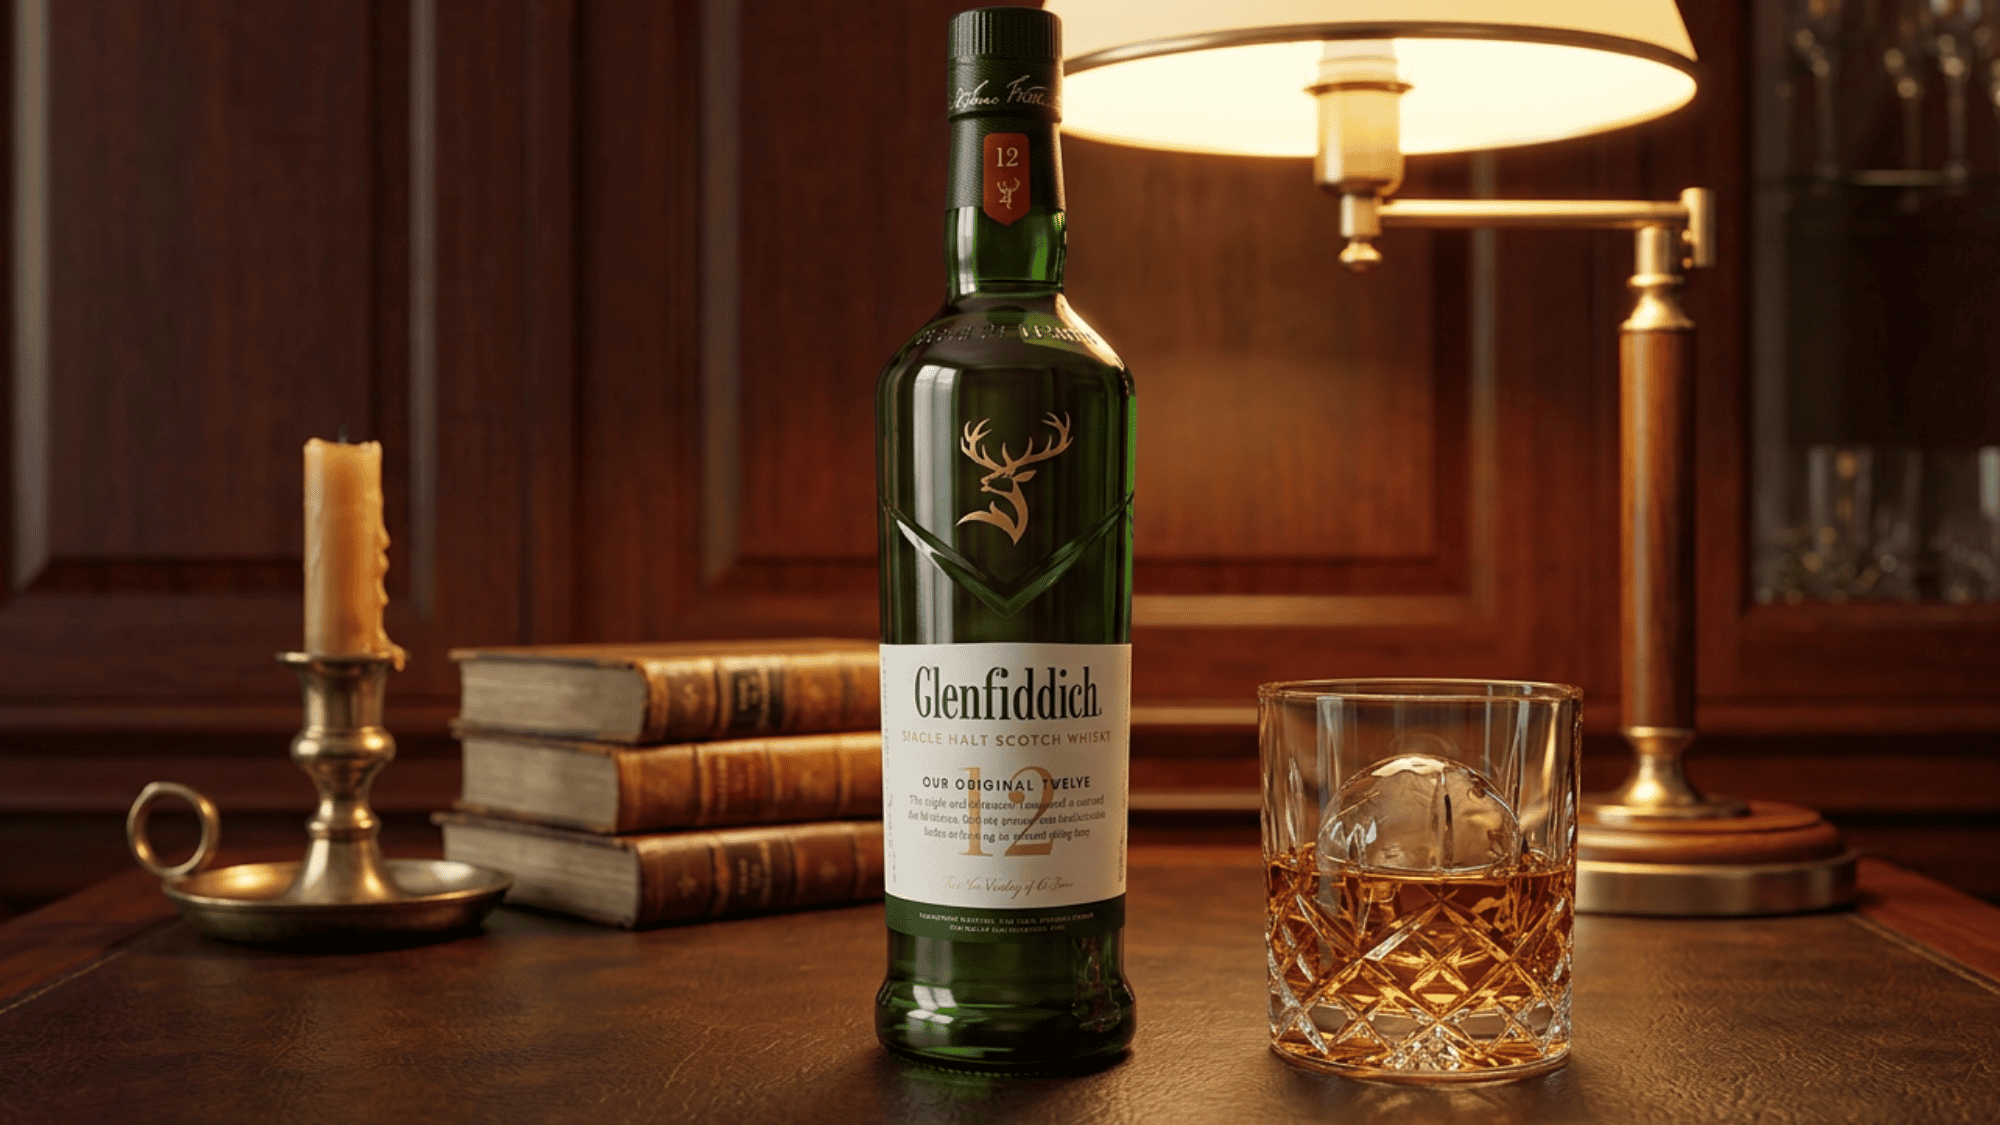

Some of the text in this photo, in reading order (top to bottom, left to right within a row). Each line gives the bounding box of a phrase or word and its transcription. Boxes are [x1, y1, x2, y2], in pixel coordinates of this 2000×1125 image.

[997, 147, 1019, 167] 12
[995, 734, 1061, 747] SCOTCH
[923, 776, 948, 789] OUR
[960, 766, 1055, 856] 12
